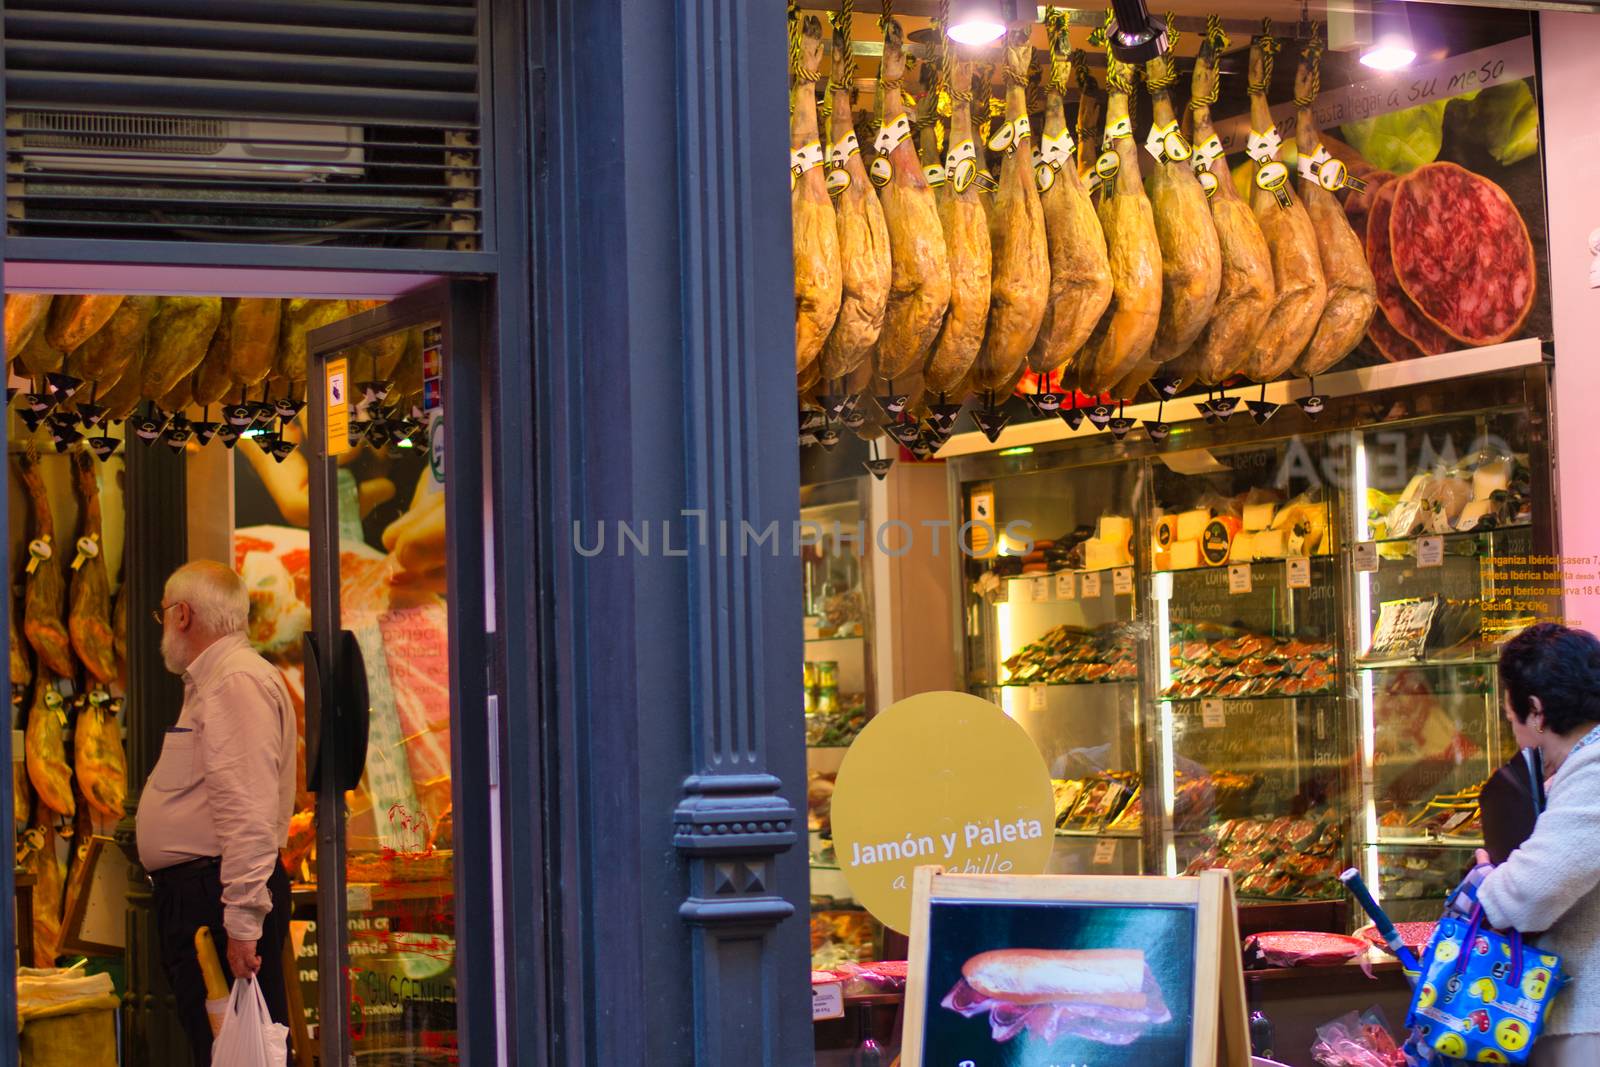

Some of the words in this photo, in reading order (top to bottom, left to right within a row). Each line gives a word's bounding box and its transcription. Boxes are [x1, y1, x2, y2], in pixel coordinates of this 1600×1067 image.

[1386, 89, 1400, 107] a
[1407, 77, 1437, 103] su
[1582, 586, 1592, 596] 18
[850, 832, 935, 868] Jamón
[940, 832, 958, 860] y
[963, 818, 1043, 849] Paleta
[891, 874, 908, 890] a
